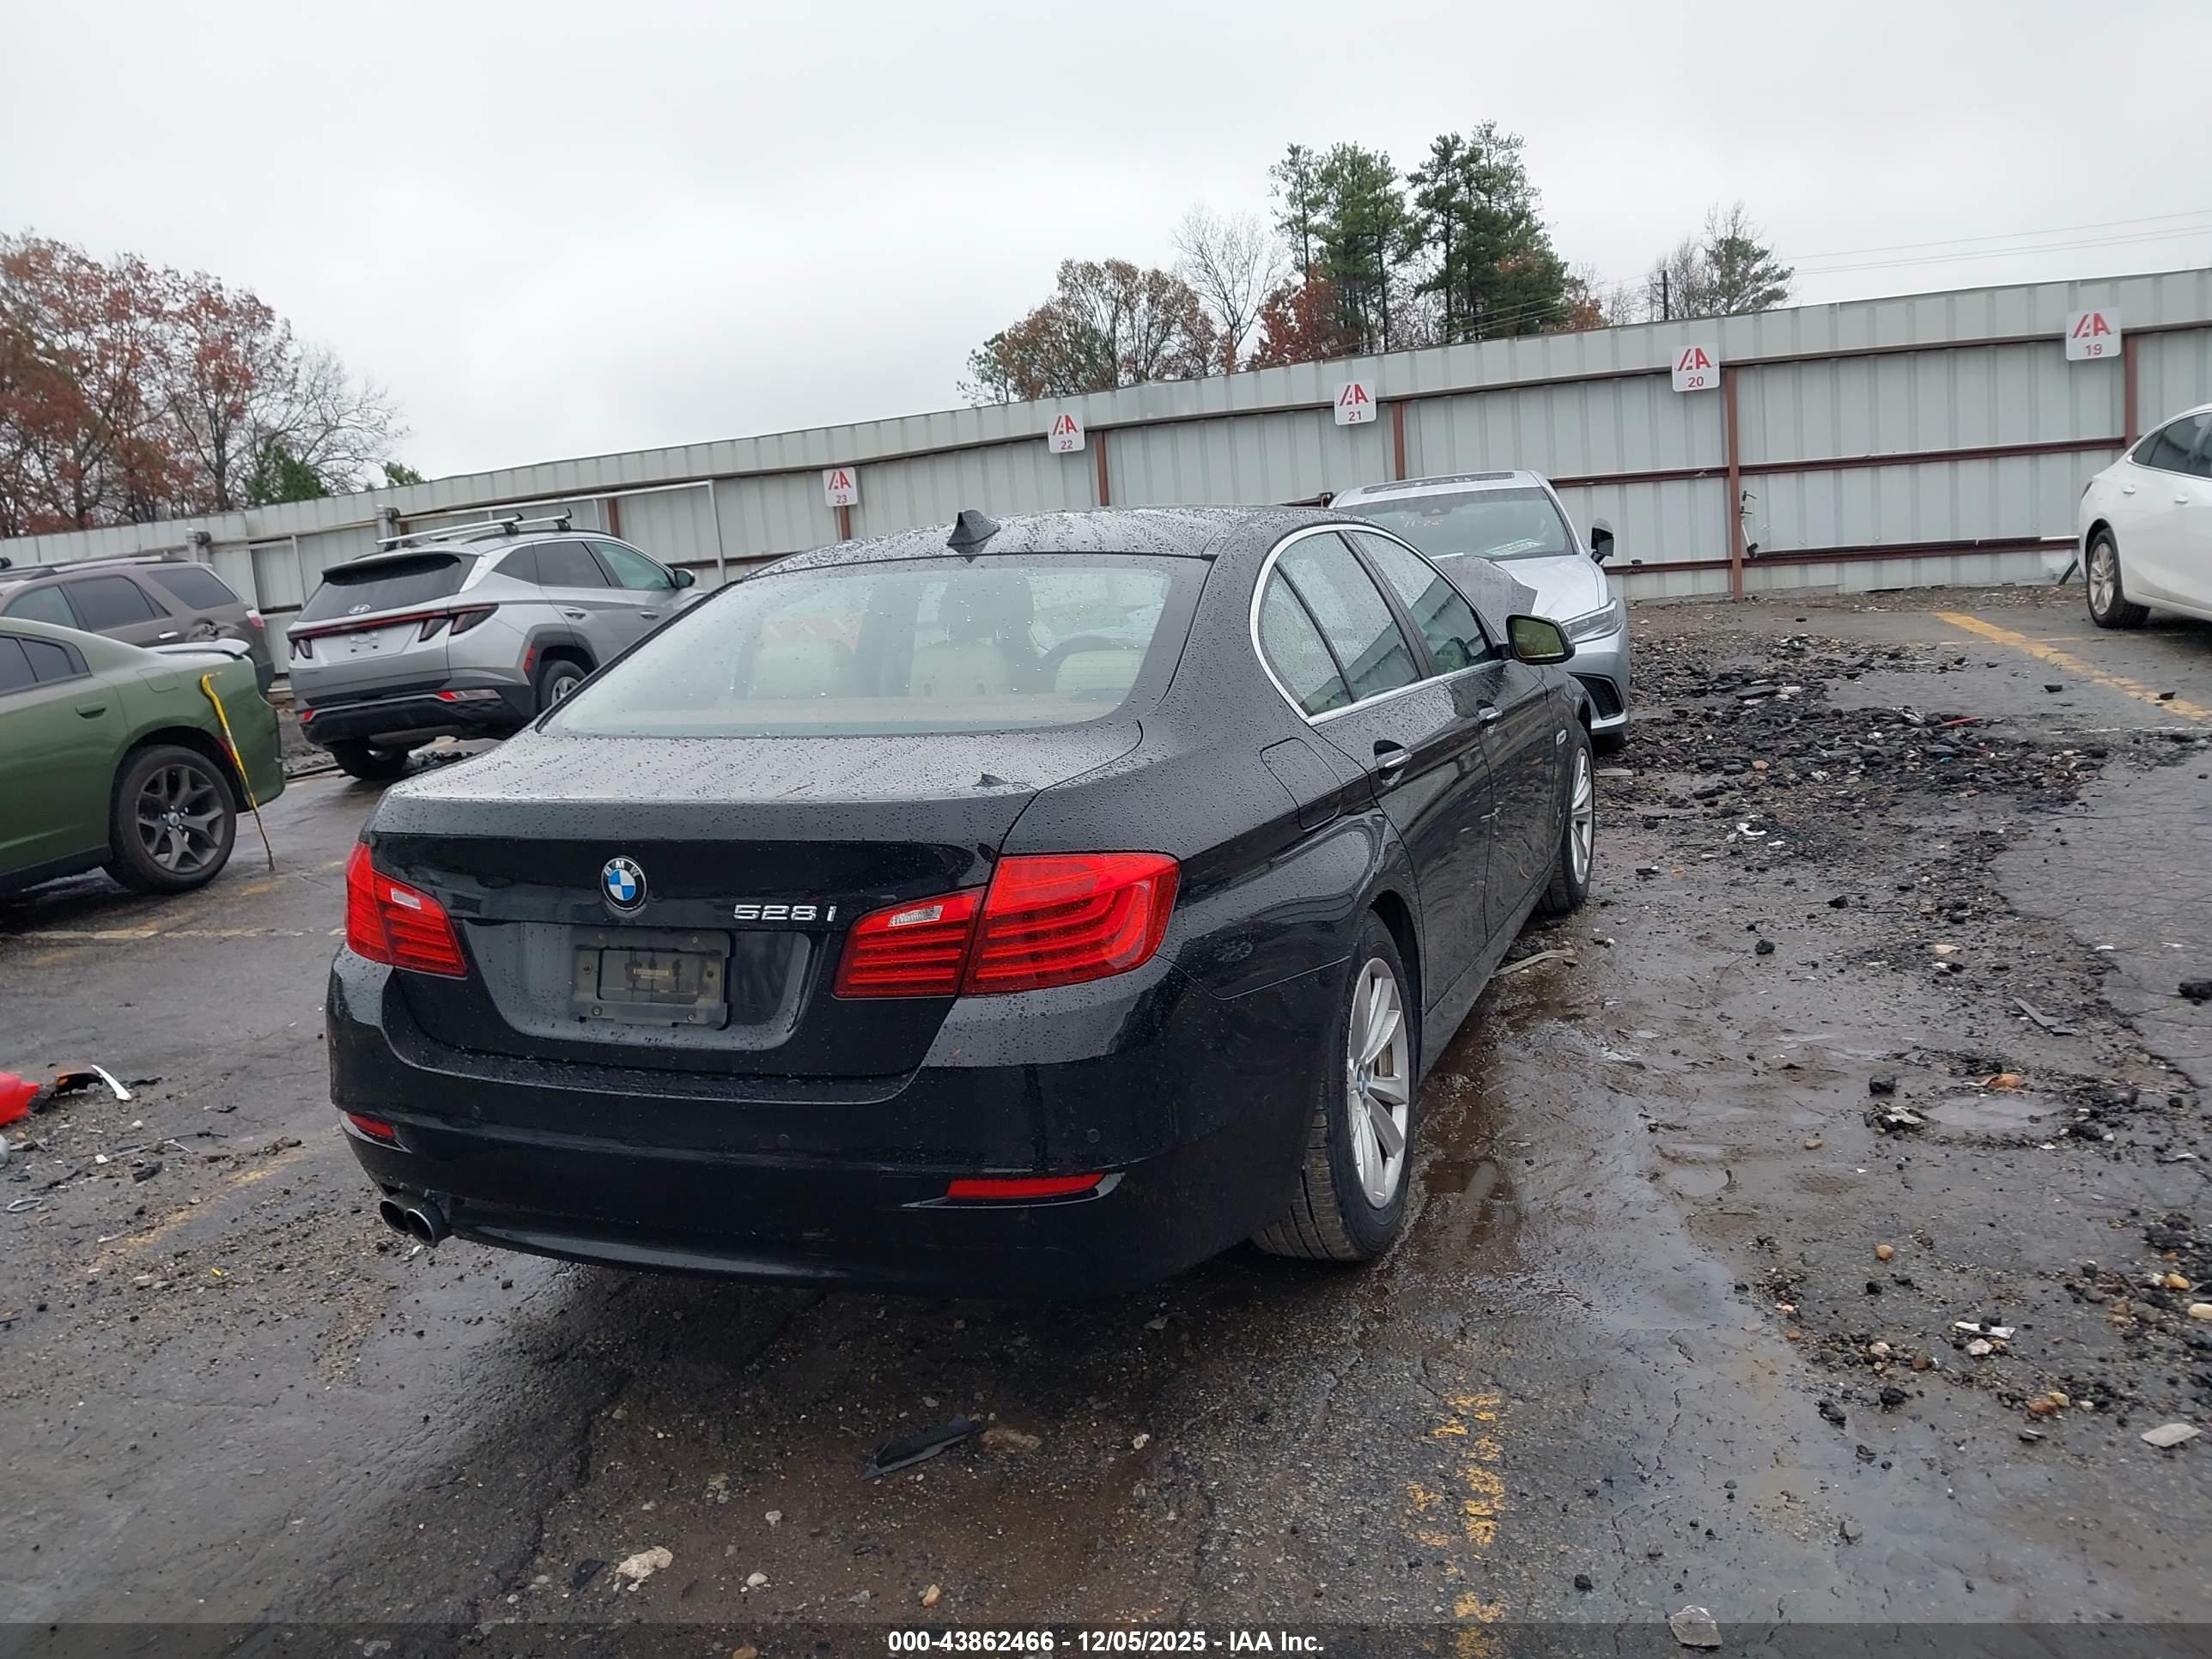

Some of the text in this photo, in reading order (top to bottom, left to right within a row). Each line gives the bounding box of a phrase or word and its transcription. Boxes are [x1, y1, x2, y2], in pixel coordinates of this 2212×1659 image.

[2085, 343, 2103, 356] 19
[1688, 376, 1705, 388] 20
[1348, 410, 1362, 422] 21
[1060, 440, 1073, 450] 22
[836, 494, 848, 505] 23
[604, 860, 641, 878] BMW
